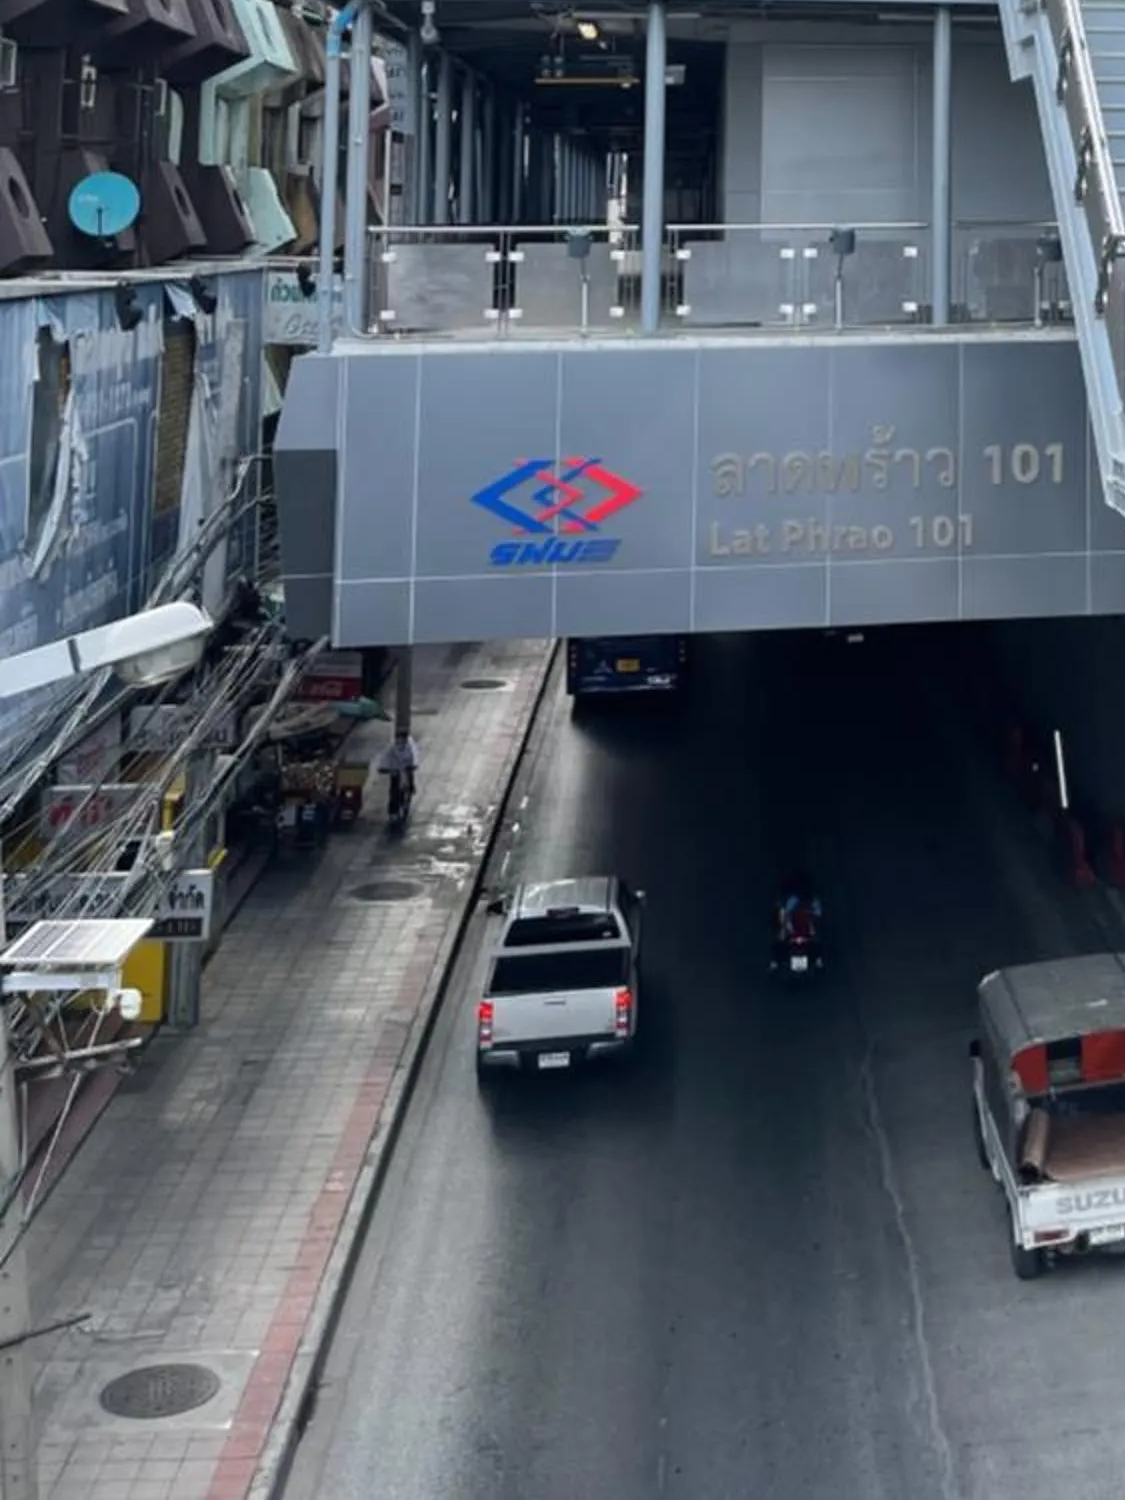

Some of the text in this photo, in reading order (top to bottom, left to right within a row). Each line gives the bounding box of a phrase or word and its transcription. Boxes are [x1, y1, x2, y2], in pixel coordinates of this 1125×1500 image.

[709, 424, 1065, 497] ลาดพร้าว 101
[709, 513, 974, 556] Lat Phrao 101
